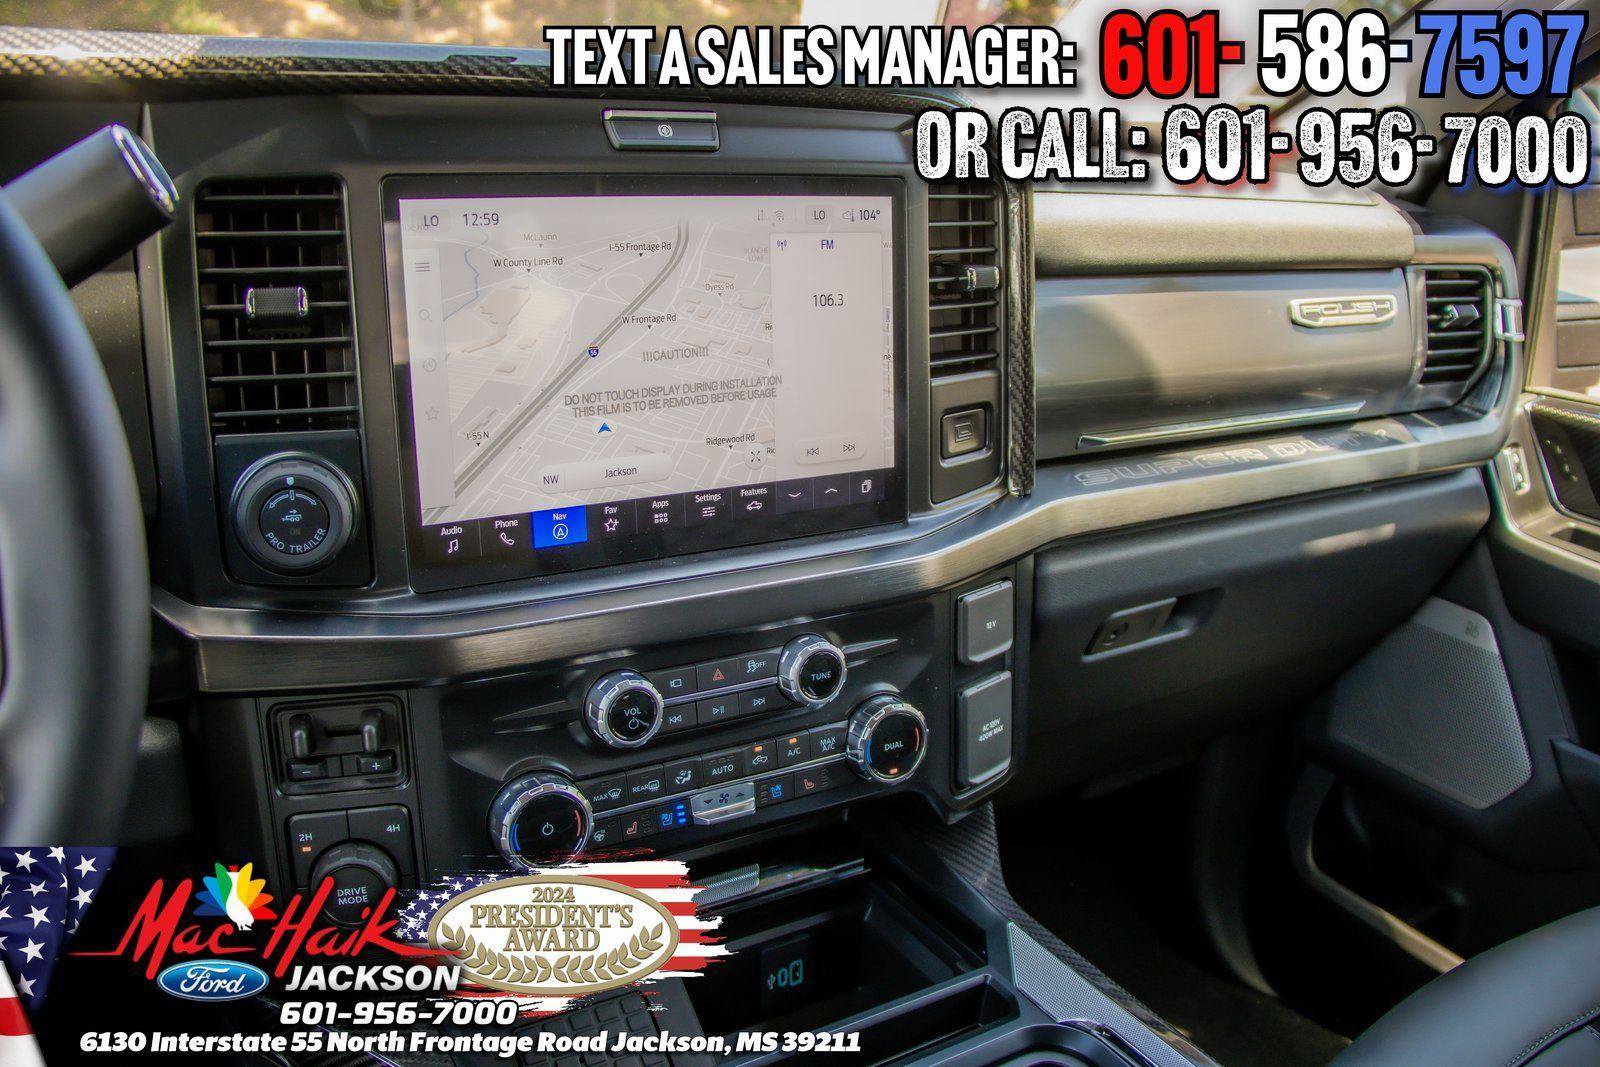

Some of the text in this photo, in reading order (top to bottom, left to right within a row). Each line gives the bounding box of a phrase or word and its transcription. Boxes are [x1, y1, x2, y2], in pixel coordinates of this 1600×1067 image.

[423, 213, 500, 227] LO 12:59
[813, 210, 826, 221] LO
[859, 209, 881, 221] 104°
[609, 241, 672, 255] I-55 Frontage Rd
[820, 240, 835, 249] FM
[493, 257, 564, 270] W County Line Rd
[705, 281, 735, 293] Dyess Rd
[812, 293, 845, 307] 106.3
[1300, 301, 1393, 317] ROUSH
[622, 313, 677, 328] W Frontage Rd
[564, 375, 782, 406] DO NOT TOUCH DISPLAY DURING INSTALLATION
[572, 387, 777, 418] THIS FILM IS TO BE REMOVED BEFORE USAGE
[483, 431, 490, 439] N
[706, 432, 756, 446] Ridgewood Rd
[604, 466, 638, 478] Jackson
[1074, 446, 1269, 487] SUPER
[543, 474, 559, 485] NW
[740, 486, 768, 497] Features
[695, 492, 722, 503] Settings
[604, 505, 618, 514] Fav
[652, 499, 669, 510] Apps
[552, 512, 567, 521] Nav
[495, 518, 519, 529] Phone
[441, 525, 463, 536] Audio
[265, 527, 326, 553] PRO TRAILER
[753, 660, 767, 670] OFF
[810, 669, 832, 682] TUNE
[623, 706, 642, 717] VOL
[820, 736, 836, 746] MAX
[884, 741, 904, 751] DUAL
[787, 746, 801, 757] A/C
[821, 742, 836, 753] A/C
[711, 764, 734, 775] AUTO
[632, 784, 650, 794] REAR
[593, 793, 609, 803] MAX
[385, 824, 401, 833] 4H
[298, 832, 313, 842] 2H
[337, 886, 368, 898] DRIVE
[338, 895, 369, 906] MODE
